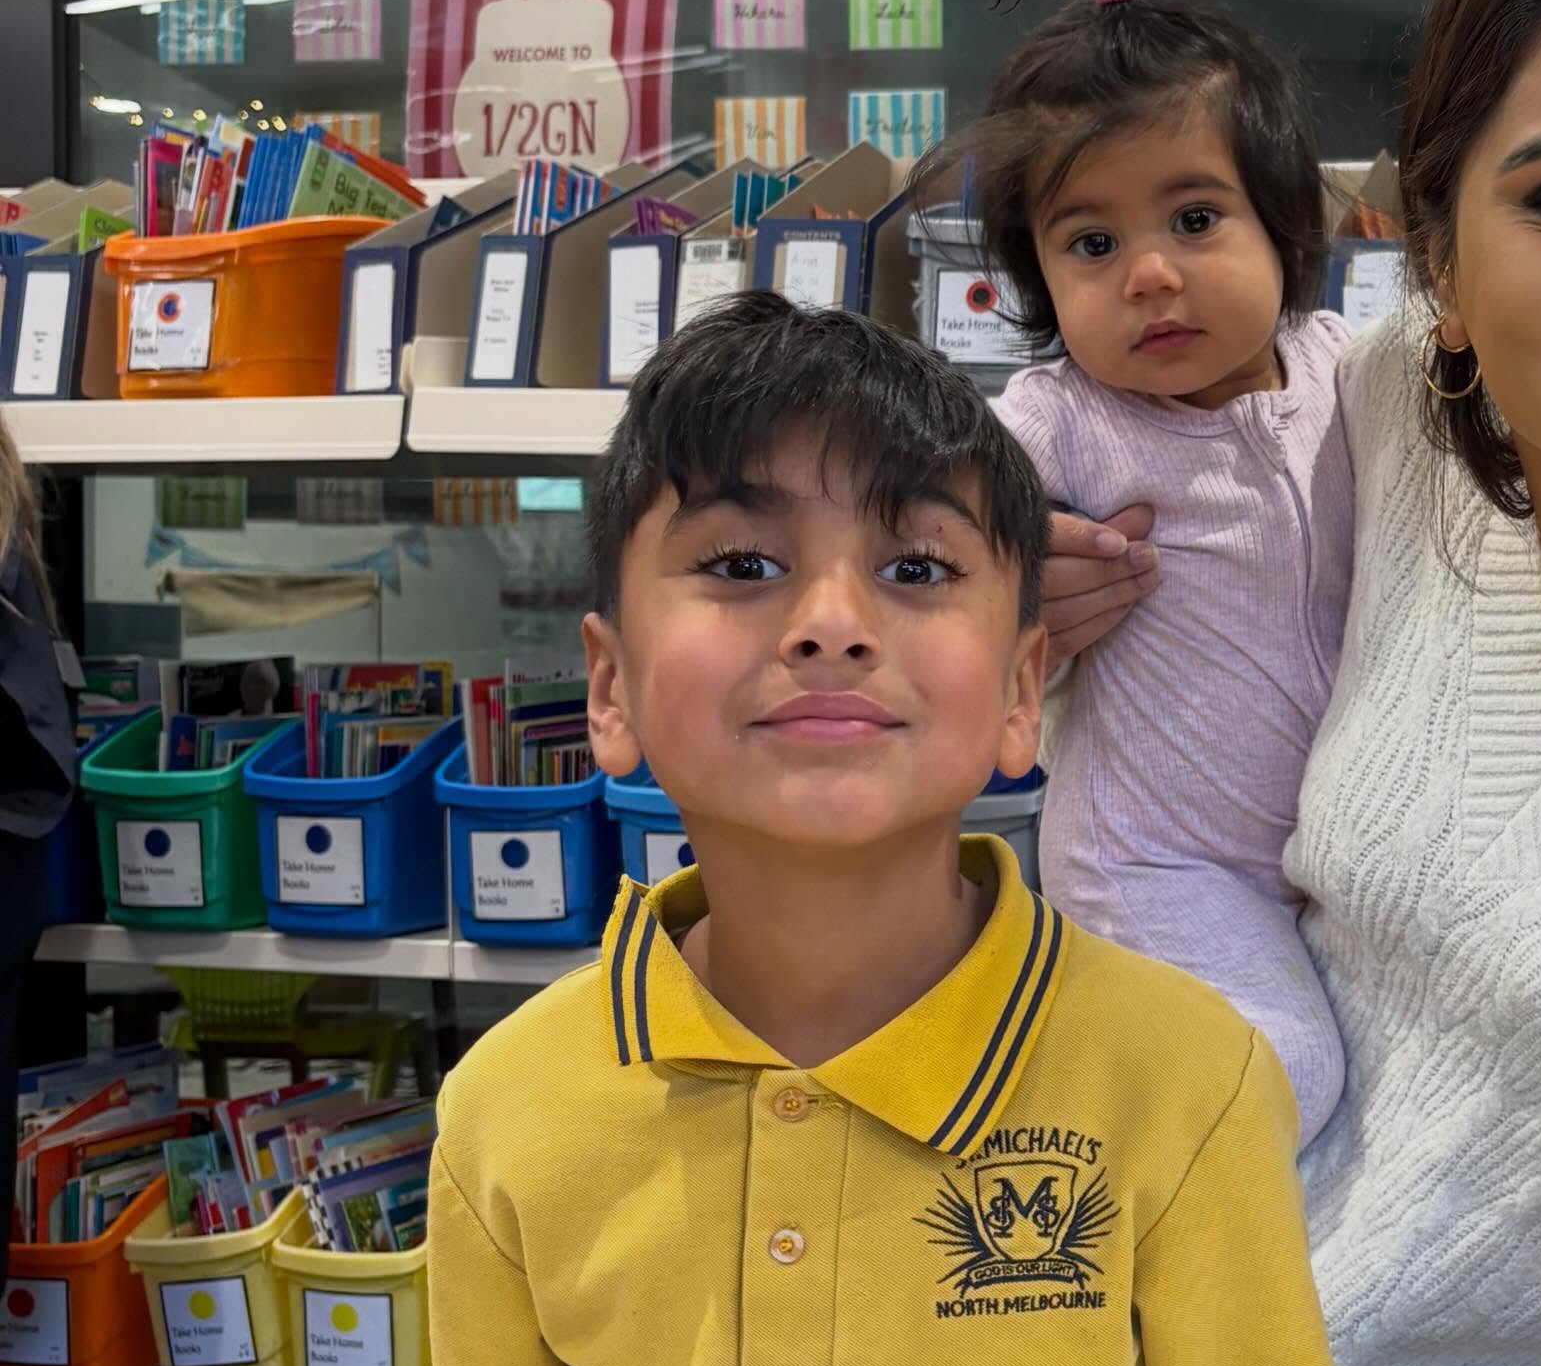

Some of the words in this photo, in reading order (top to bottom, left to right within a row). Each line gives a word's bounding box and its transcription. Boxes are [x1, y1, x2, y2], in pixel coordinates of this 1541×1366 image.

[493, 46, 566, 62] WELCOME
[571, 44, 592, 60] TO
[482, 99, 597, 156] 1/2GN
[335, 172, 359, 209] Big
[942, 318, 965, 331] Take
[968, 318, 1001, 331] Home
[940, 337, 971, 348] Books
[477, 876, 499, 888] Take
[502, 877, 534, 888] Home
[478, 895, 508, 906] Books
[974, 1265, 1000, 1280] GOD
[1001, 1264, 1013, 1275] IS
[1015, 1262, 1040, 1274] OUR
[1042, 1262, 1073, 1276] LIGHT
[172, 1327, 192, 1339] Take
[311, 1334, 331, 1346] Take
[333, 1336, 363, 1348] Home
[311, 1350, 338, 1363] Books
